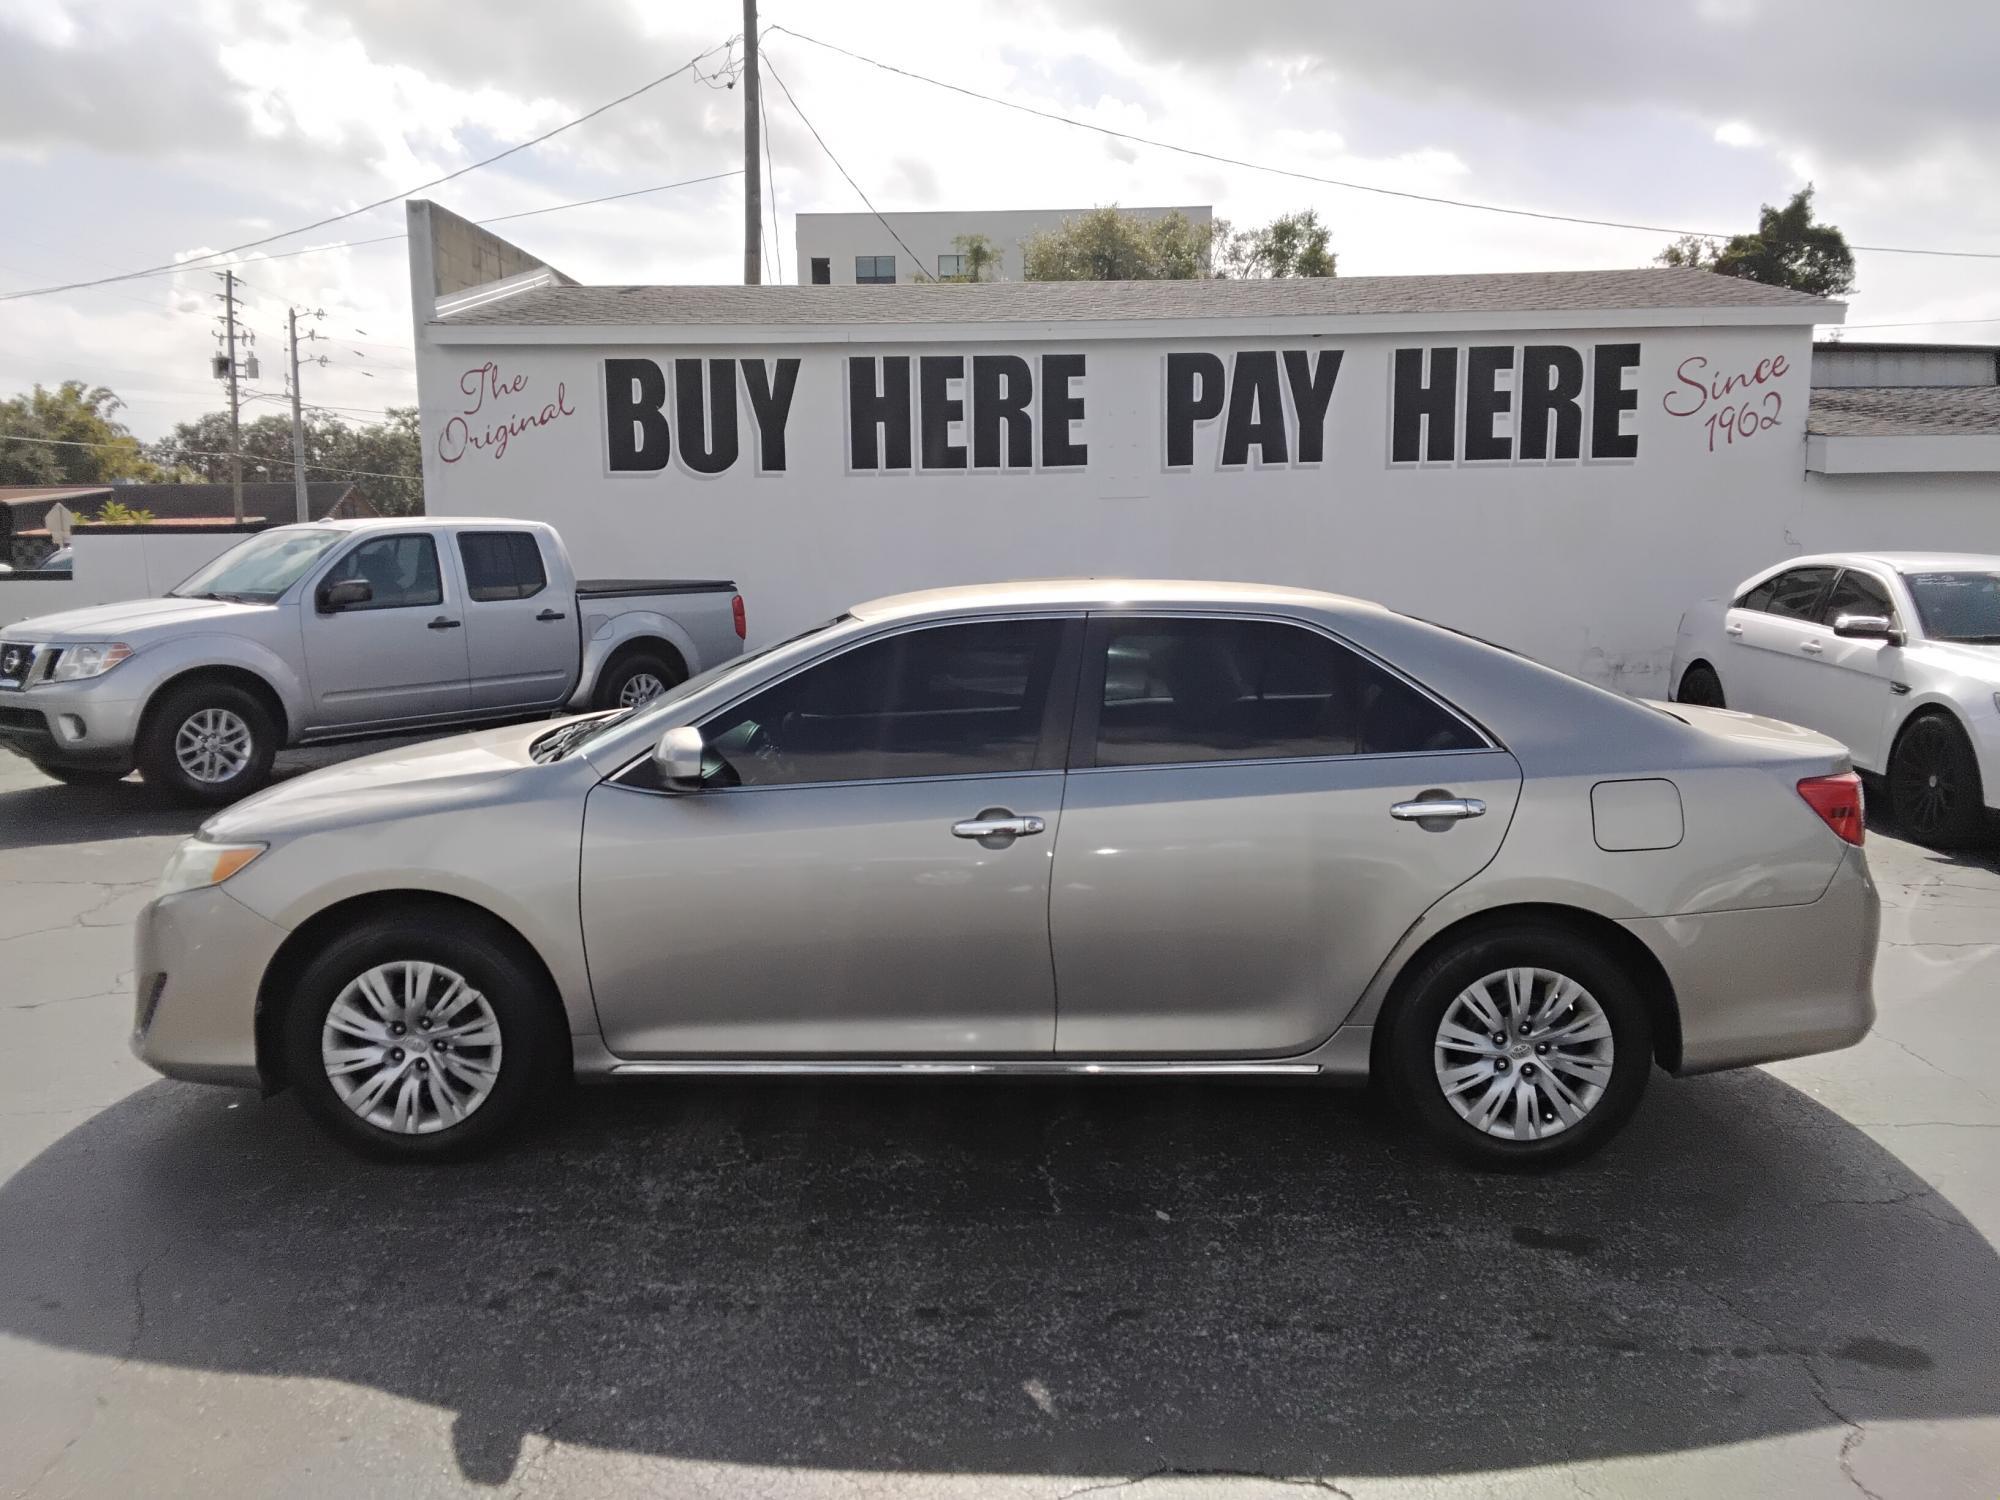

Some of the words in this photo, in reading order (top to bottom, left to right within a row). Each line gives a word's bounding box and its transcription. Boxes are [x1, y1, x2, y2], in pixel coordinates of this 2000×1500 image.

[460, 361, 529, 415] The
[603, 357, 801, 474] BUY
[849, 353, 1088, 470] HERE
[1166, 349, 1345, 467] PAY
[1391, 342, 1641, 463] HERE
[1663, 355, 1790, 417] Since
[438, 381, 576, 463] Original
[1704, 391, 1782, 452] 1962
